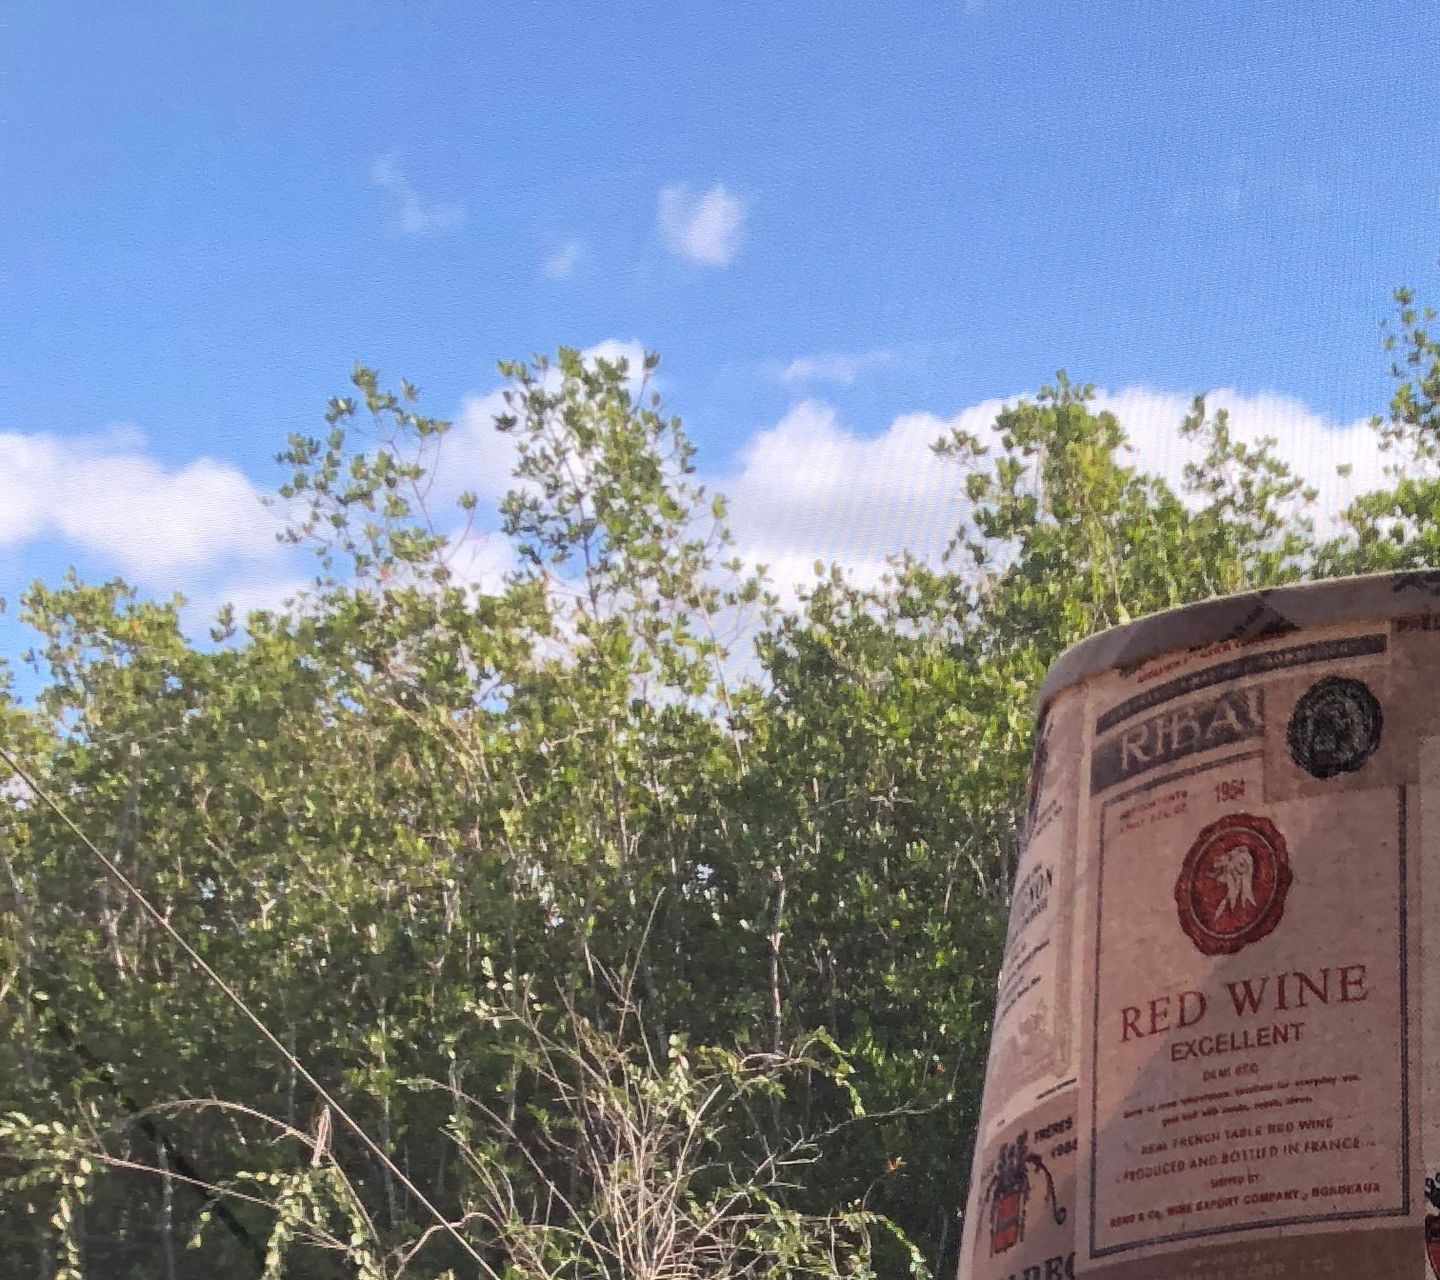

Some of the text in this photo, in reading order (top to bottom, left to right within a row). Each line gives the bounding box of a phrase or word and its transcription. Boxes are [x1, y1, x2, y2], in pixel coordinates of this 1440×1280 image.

[1119, 964, 1370, 1043] RED WINE
[1170, 1022, 1306, 1062] EXCELLENT
[1172, 1131, 1221, 1149] FRENCH
[1224, 1126, 1262, 1140] TABLE
[1267, 1121, 1294, 1135] RED
[1298, 1117, 1334, 1132] WINE
[1190, 1154, 1218, 1170] AND
[1282, 1142, 1300, 1156] IN
[1304, 1136, 1361, 1154] FRANCE
[1196, 1195, 1241, 1212] EXPORT
